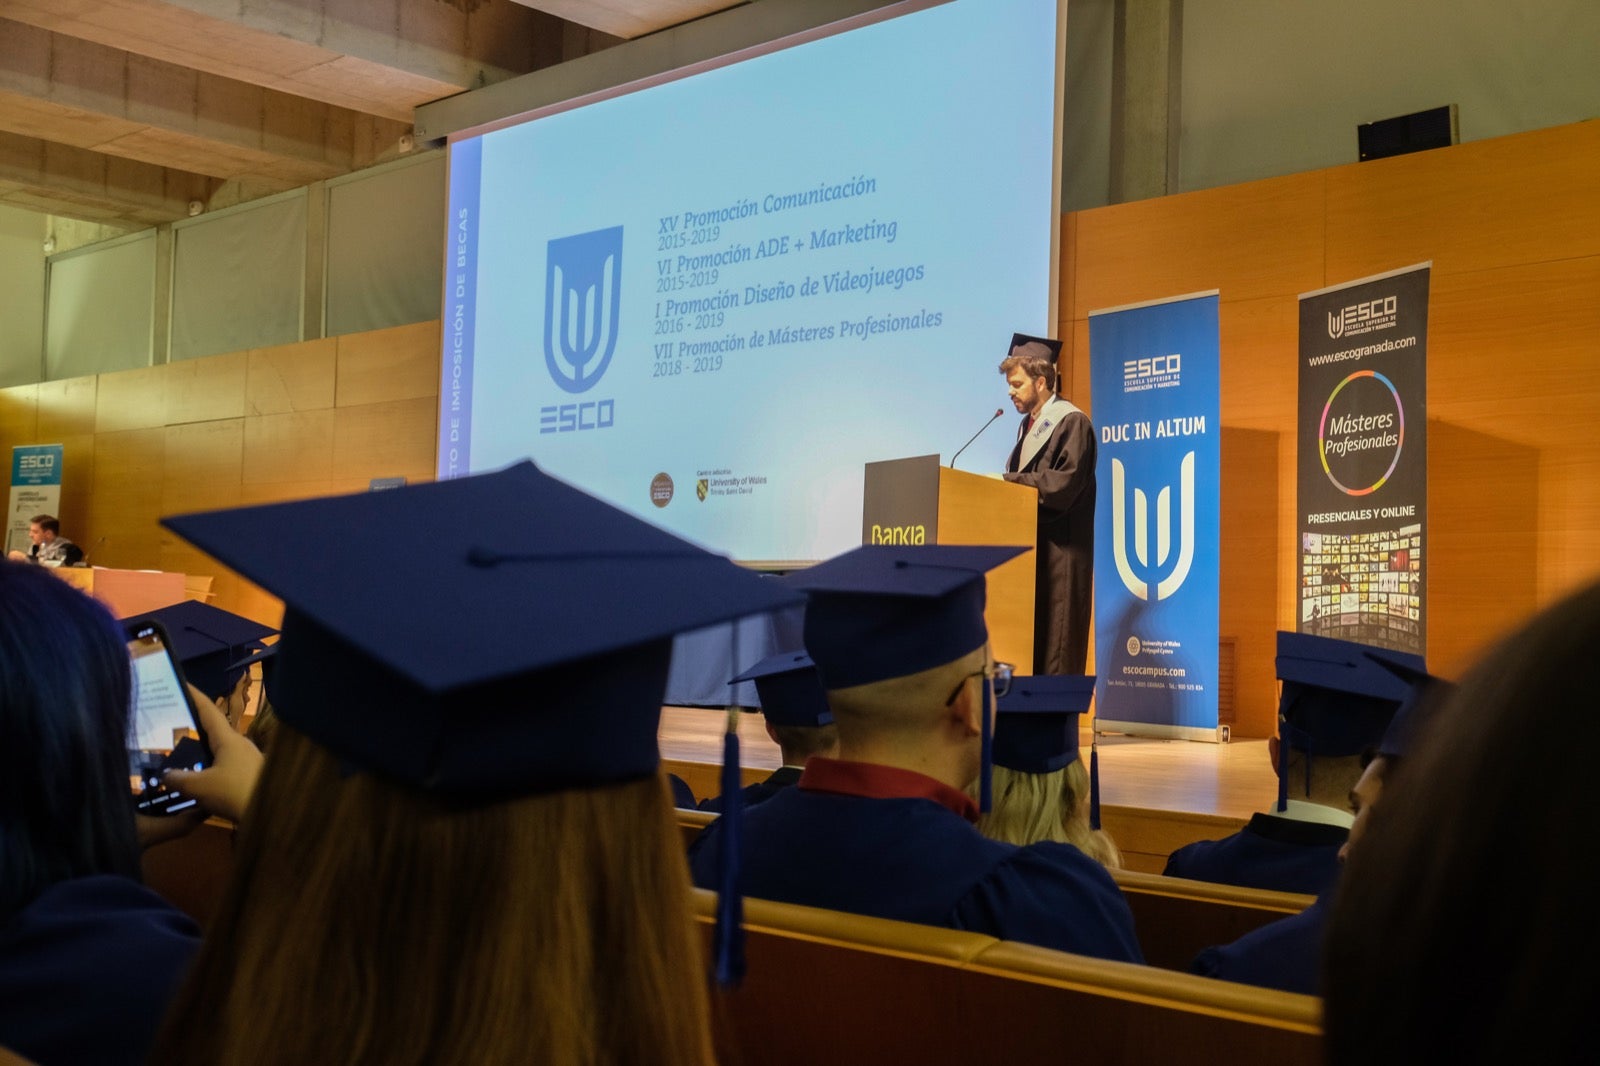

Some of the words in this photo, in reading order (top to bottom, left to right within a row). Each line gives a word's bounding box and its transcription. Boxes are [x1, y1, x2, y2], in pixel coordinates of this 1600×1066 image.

[658, 216, 679, 234] XV
[684, 199, 758, 229] Promoción
[763, 175, 877, 213] Comunicación
[457, 207, 468, 268] BECAS
[657, 259, 672, 276] VI
[677, 244, 751, 272] Promoción
[755, 236, 789, 260] ADE
[794, 239, 804, 251] +
[809, 219, 898, 250] Marketing
[658, 226, 720, 251] 2015-2019
[456, 273, 466, 298] DE
[655, 303, 661, 318] I
[665, 290, 739, 317] Promoción
[744, 280, 795, 305] Diseño
[800, 276, 819, 297] de
[823, 264, 925, 294] Videojuegos
[656, 269, 719, 293] 2015-2019
[1344, 295, 1397, 324] ESCO
[654, 343, 673, 360] VII
[678, 330, 745, 357] Promoción
[749, 331, 764, 348] de
[768, 325, 835, 346] Másteres
[840, 309, 943, 341] Profesionales
[655, 317, 684, 335] 2016
[695, 312, 724, 329] 2019
[452, 303, 465, 411] IMPOSICIÓN
[1309, 336, 1416, 367] www.escogranada.com
[653, 360, 682, 377] 2018
[694, 355, 723, 373] 2019
[1124, 354, 1180, 380] ESCO
[540, 399, 614, 434] ESCO
[1102, 424, 1130, 443] DUC
[1135, 422, 1150, 440] IN
[1156, 416, 1206, 438] ALTUM
[1329, 413, 1394, 436] Másteres
[450, 418, 460, 442] DE
[1324, 431, 1398, 457] Profesionales
[20, 454, 54, 468] ESCO
[448, 448, 458, 480] CTO
[711, 477, 740, 487] University
[1308, 509, 1372, 524] PRESENCIALES
[1373, 508, 1380, 519] Y
[1380, 505, 1416, 518] ONLINE
[871, 525, 925, 546] Bankia
[1122, 666, 1186, 678] escocampus.com
